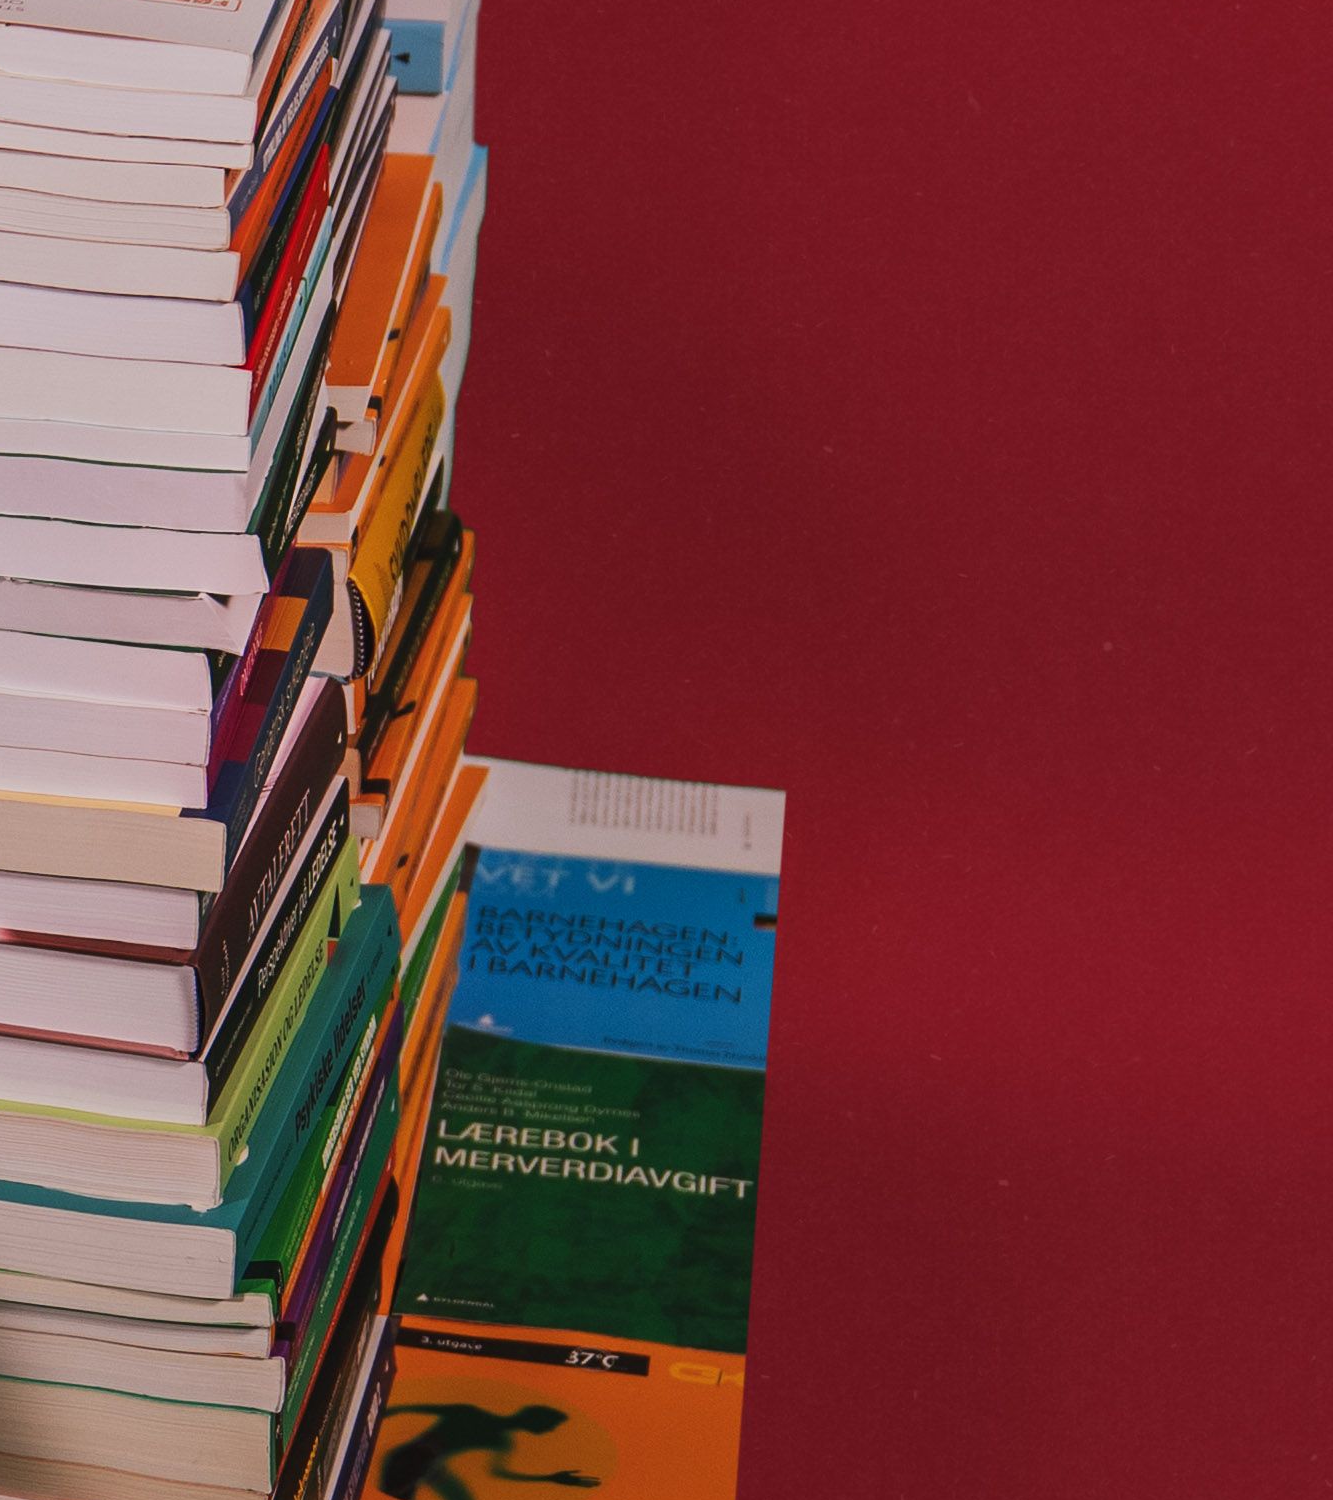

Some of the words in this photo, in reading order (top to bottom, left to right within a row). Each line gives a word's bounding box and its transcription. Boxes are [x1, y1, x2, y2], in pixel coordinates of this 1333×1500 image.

[247, 787, 310, 944] AVTALERETT
[476, 861, 571, 892] VET
[586, 870, 637, 896] VI
[470, 939, 520, 956] AV
[529, 943, 699, 980] KVALITET
[474, 921, 745, 969] BETYDNINGEN
[487, 958, 742, 1005] BARNEHAGEN
[294, 1052, 334, 1144] Psykiske
[333, 979, 367, 1059] lidelser
[437, 1118, 620, 1157] LÆREBOK
[433, 1145, 755, 1200] MERVERDIAVGIFT
[435, 1337, 484, 1352] utgave
